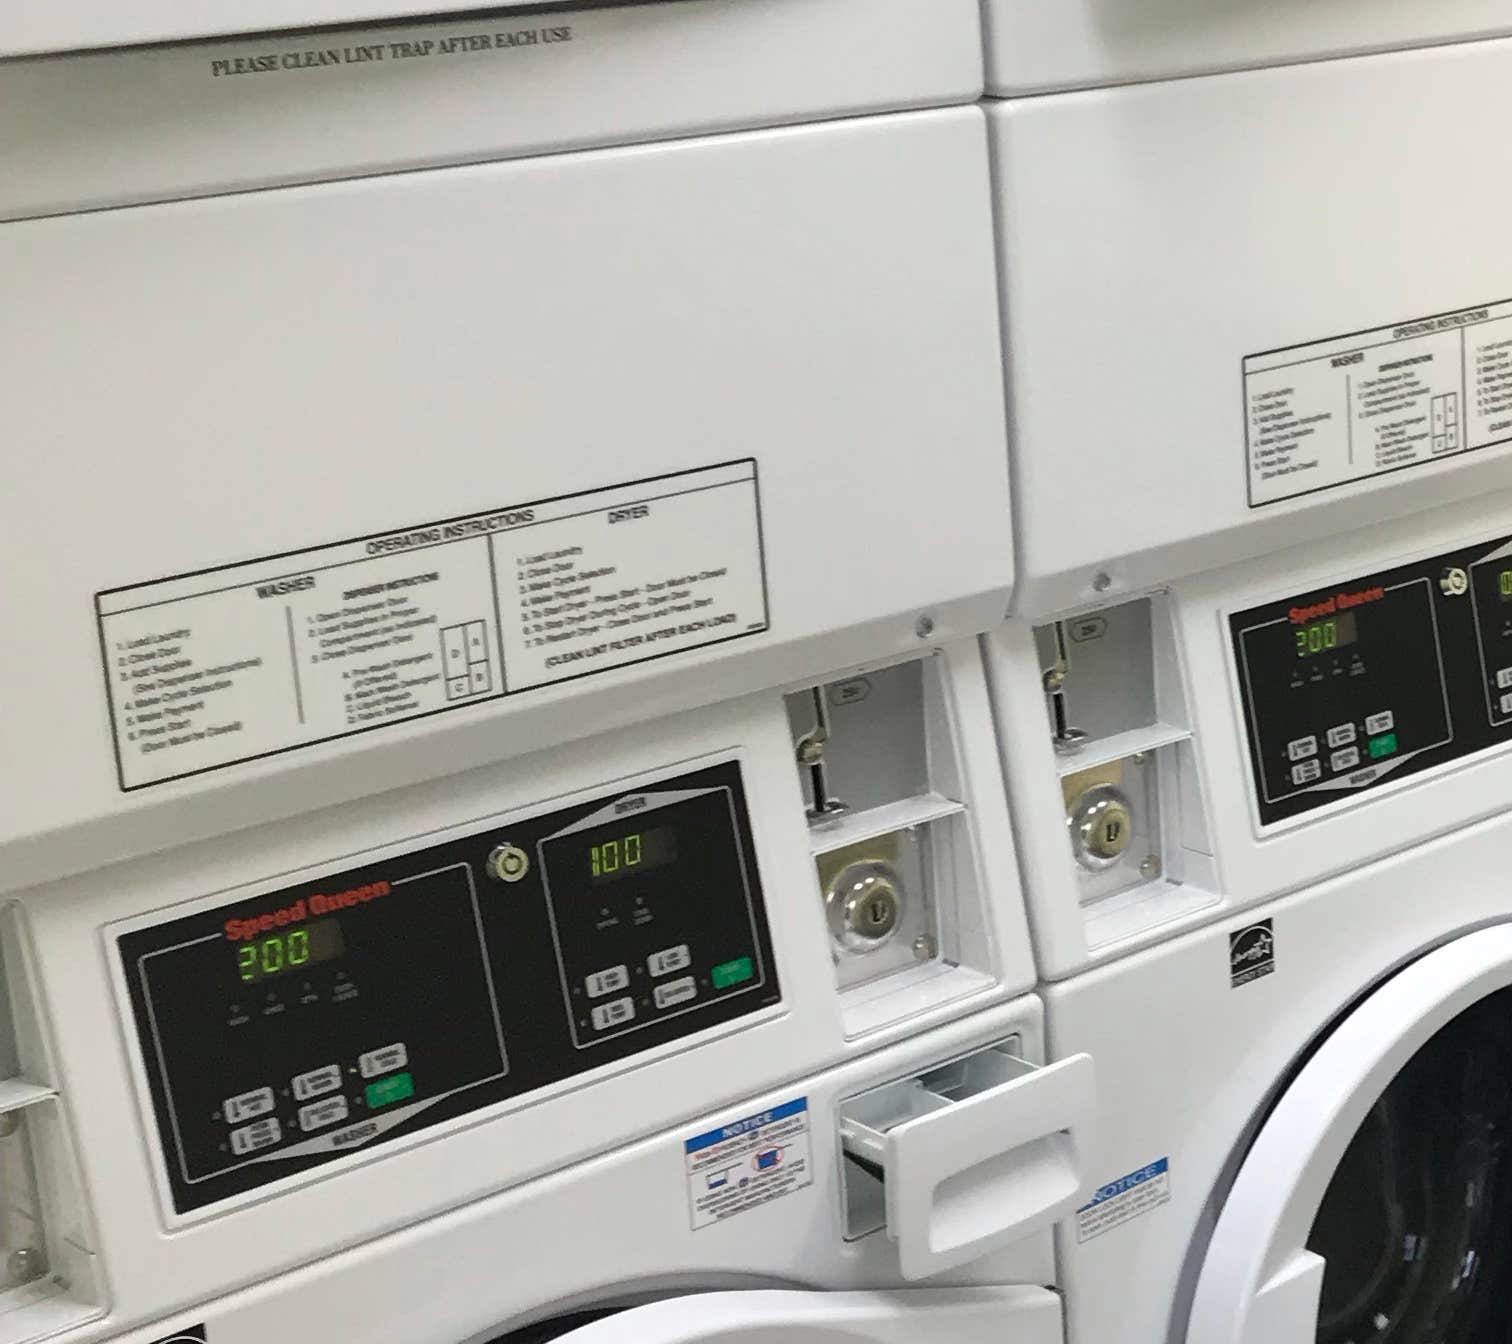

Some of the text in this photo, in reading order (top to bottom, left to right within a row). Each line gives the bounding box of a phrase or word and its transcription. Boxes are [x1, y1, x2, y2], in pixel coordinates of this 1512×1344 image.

[212, 26, 573, 77] PLEASE CLEAN LINT TRAP AFTER EACH USE
[365, 509, 535, 555] OPERATING INSTRUCTIONS
[607, 504, 649, 525] DRYER
[255, 575, 316, 599] WASHER
[1289, 586, 1384, 625] Speed Queen
[591, 834, 641, 877] 100
[225, 879, 391, 941] Speed Queen
[331, 1122, 379, 1147] WASHER
[722, 1111, 775, 1138] NOTICE
